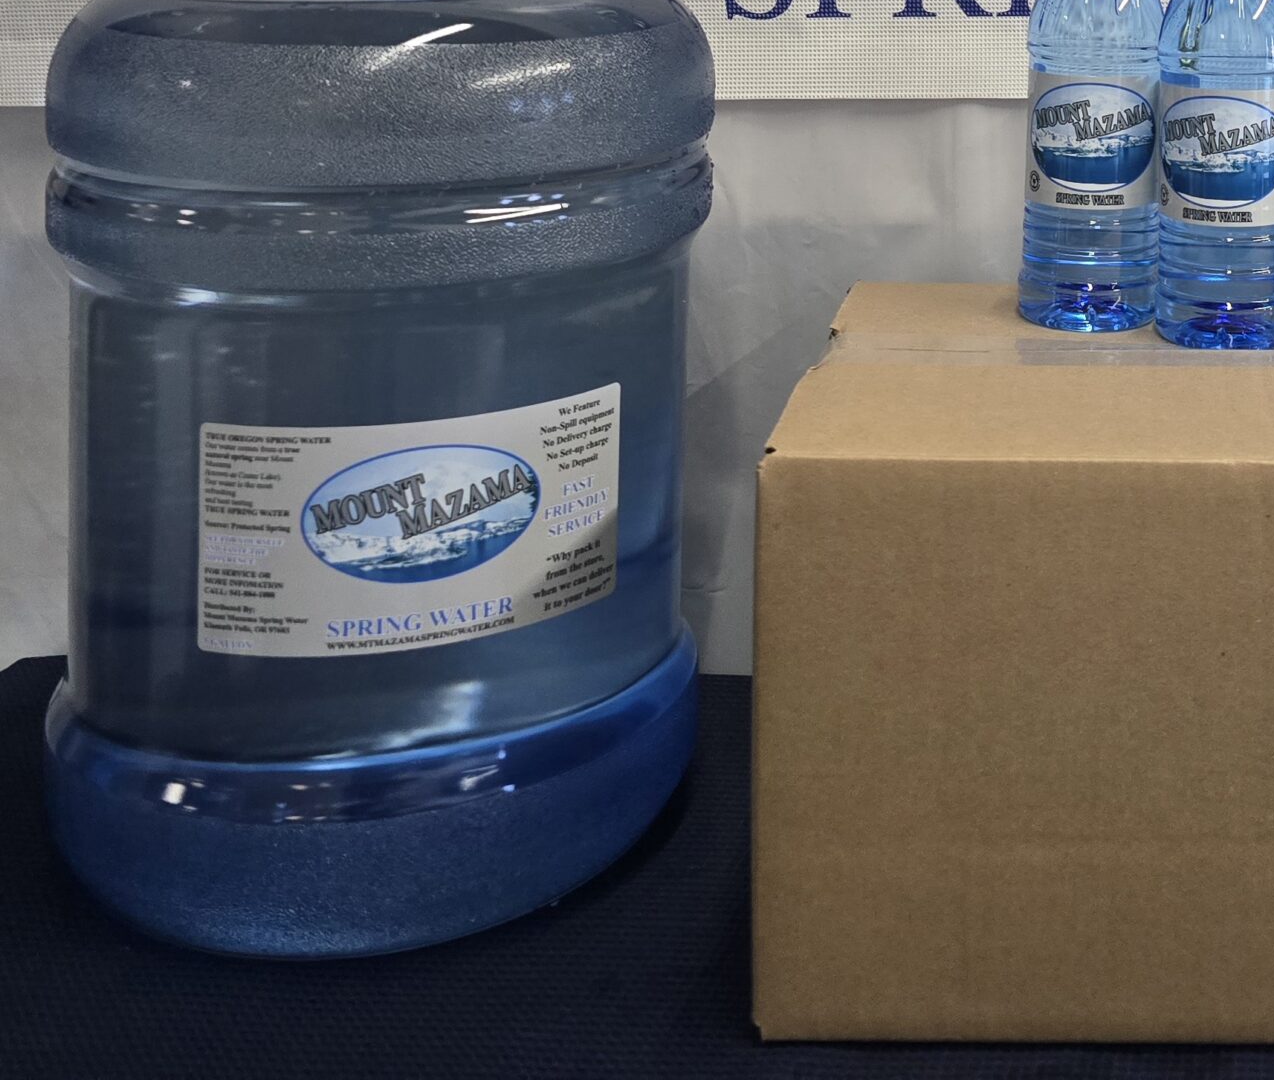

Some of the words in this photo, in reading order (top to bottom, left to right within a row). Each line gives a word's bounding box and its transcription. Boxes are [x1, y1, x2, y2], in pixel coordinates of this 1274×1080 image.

[1035, 100, 1091, 130] MOUNT
[1074, 101, 1152, 142] MAZAMA
[1056, 192, 1090, 206] SPRING
[1091, 194, 1124, 206] WATER
[1182, 207, 1217, 222] SPRING
[1218, 211, 1252, 223] WATER
[540, 419, 576, 434] Non-Spill
[579, 407, 614, 425] equipment
[559, 405, 570, 416] We
[573, 400, 600, 413] Feature
[543, 437, 554, 447] No
[556, 430, 587, 444] Delivery
[589, 422, 612, 434] charge
[547, 450, 557, 460] No
[560, 443, 584, 458] Set-up
[586, 436, 608, 447] charge
[559, 462, 569, 471] No
[571, 453, 598, 468] Deposit
[563, 476, 593, 495] FAST
[310, 473, 425, 534] MOUNT
[395, 464, 532, 540] MAZAMA
[545, 489, 607, 519] FRIENDLY
[549, 510, 603, 535] SERVICE
[573, 540, 592, 558] pack
[594, 539, 601, 548] it
[533, 586, 557, 598] when
[559, 582, 571, 590] we
[573, 575, 587, 586] can
[589, 564, 613, 580] deliver
[546, 567, 566, 580] from
[569, 561, 582, 572] the
[544, 602, 552, 611] it
[564, 591, 583, 606] your
[327, 614, 421, 638] SPRING
[429, 596, 513, 627] WATER
[326, 615, 516, 652] WWW.MTMAZAMASPRINGWATER.COM
